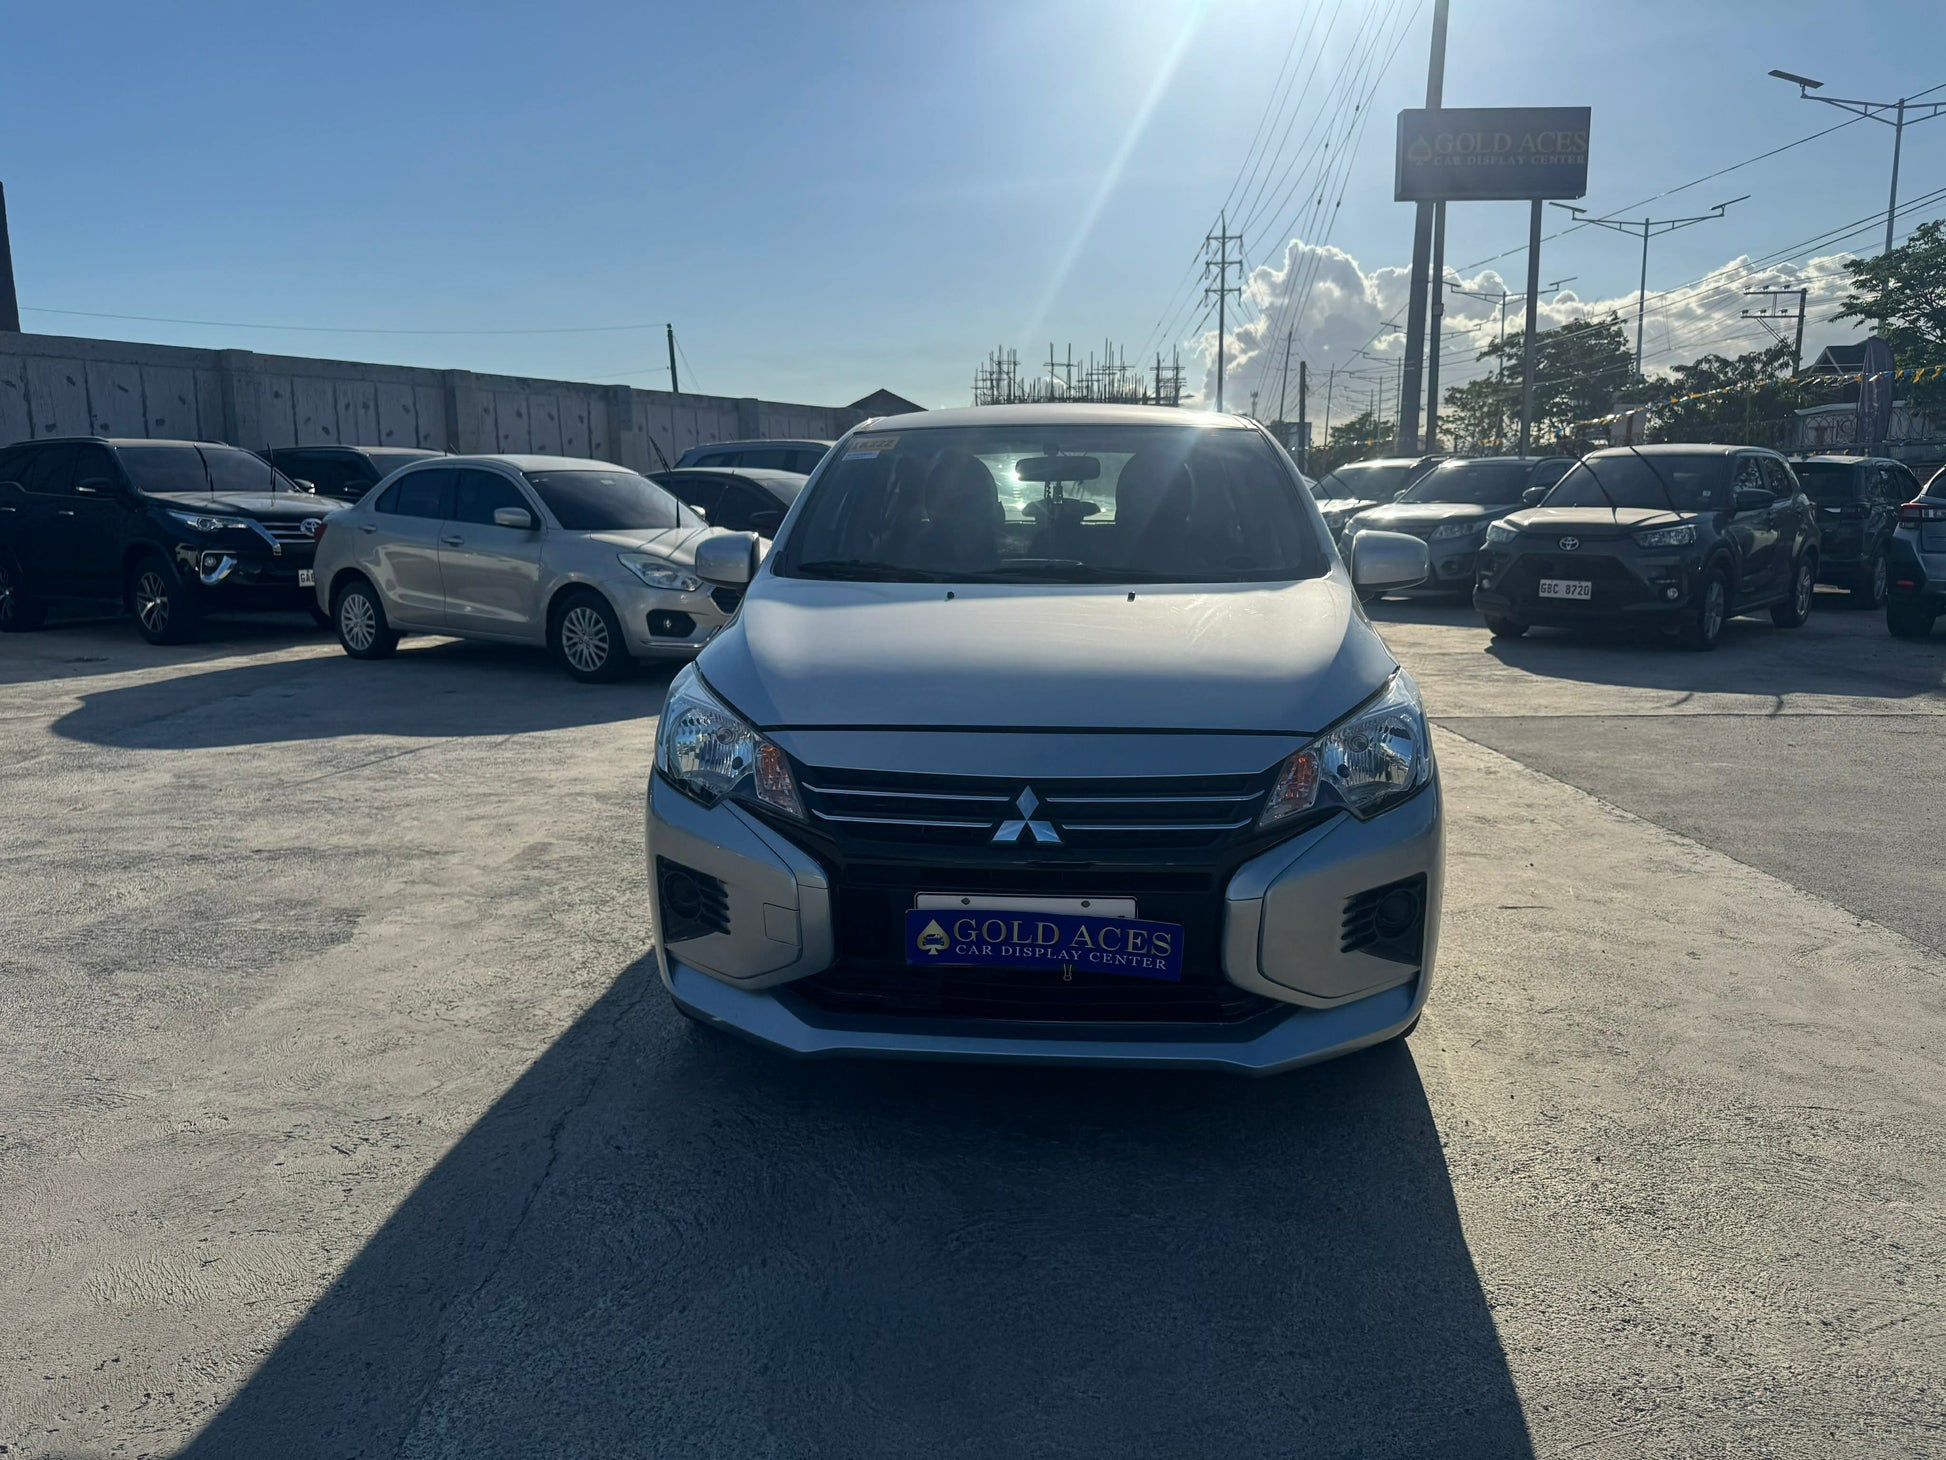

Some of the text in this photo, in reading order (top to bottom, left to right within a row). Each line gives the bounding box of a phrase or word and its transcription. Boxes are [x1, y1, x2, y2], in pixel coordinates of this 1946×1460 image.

[1435, 131, 1587, 153] GOLD ACES
[1434, 154, 1586, 166] CAR DISPLAY CENTER
[1565, 584, 1590, 596] 8720
[953, 918, 1173, 956] GOLD ACES
[955, 944, 1168, 970] CAR DISPLAY CENTER
